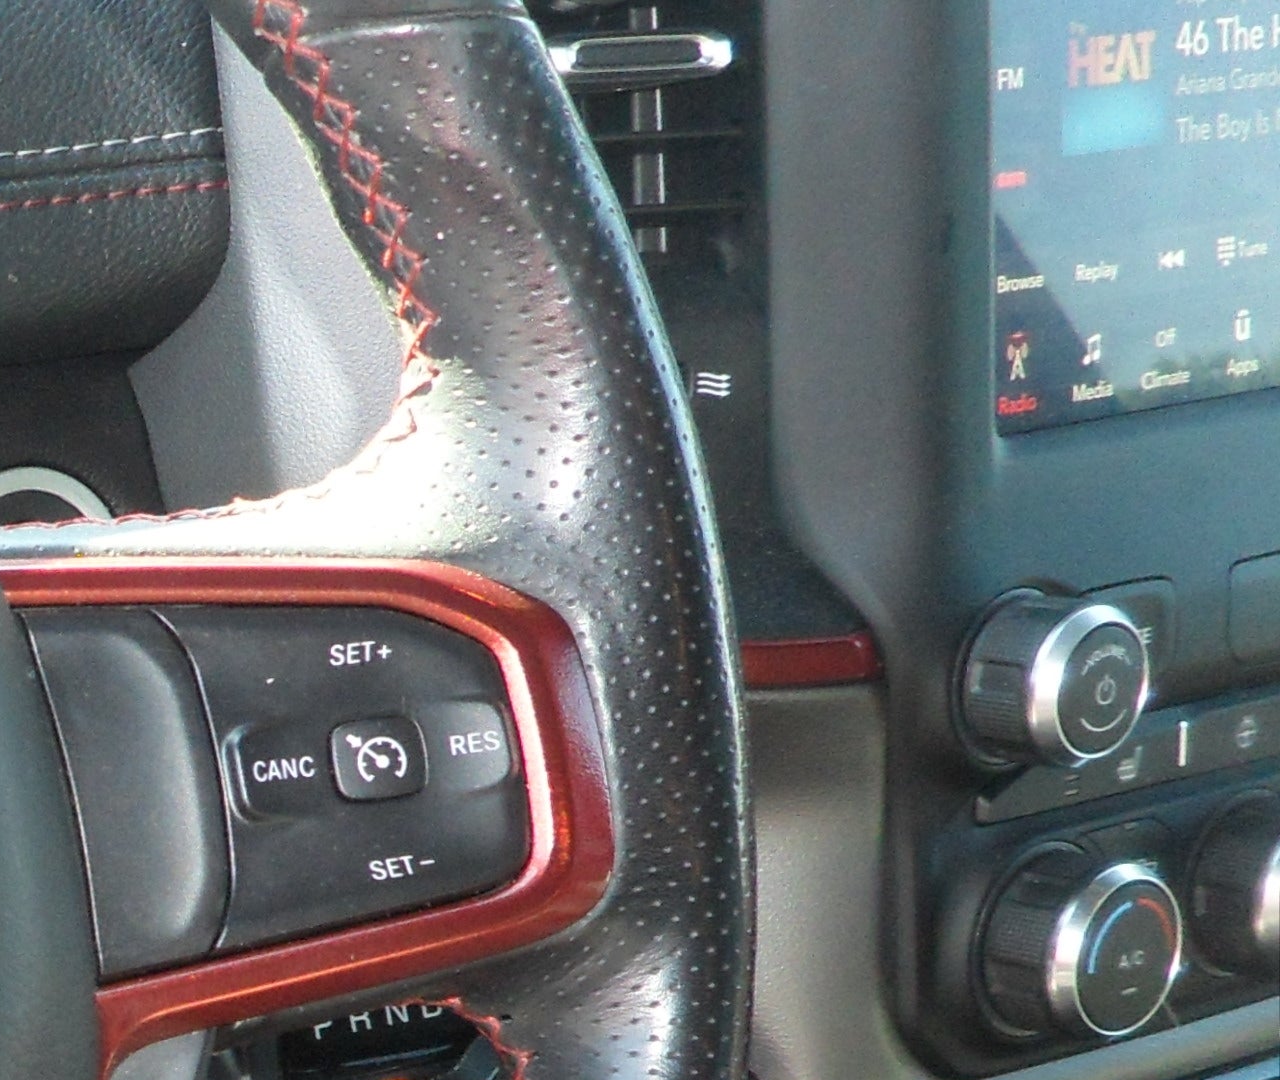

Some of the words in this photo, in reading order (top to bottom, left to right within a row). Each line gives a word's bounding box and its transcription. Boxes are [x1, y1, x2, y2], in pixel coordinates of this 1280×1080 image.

[1175, 19, 1209, 56] 46
[1215, 14, 1264, 53] The
[1067, 29, 1157, 90] HEAT
[996, 67, 1024, 91] FM
[1175, 115, 1212, 144] The
[996, 274, 1044, 294] Browse
[1074, 264, 1118, 284] Replay
[1072, 381, 1115, 402] Media
[997, 395, 1038, 416] Radio
[449, 731, 501, 756] RES
[252, 755, 316, 783] CANC
